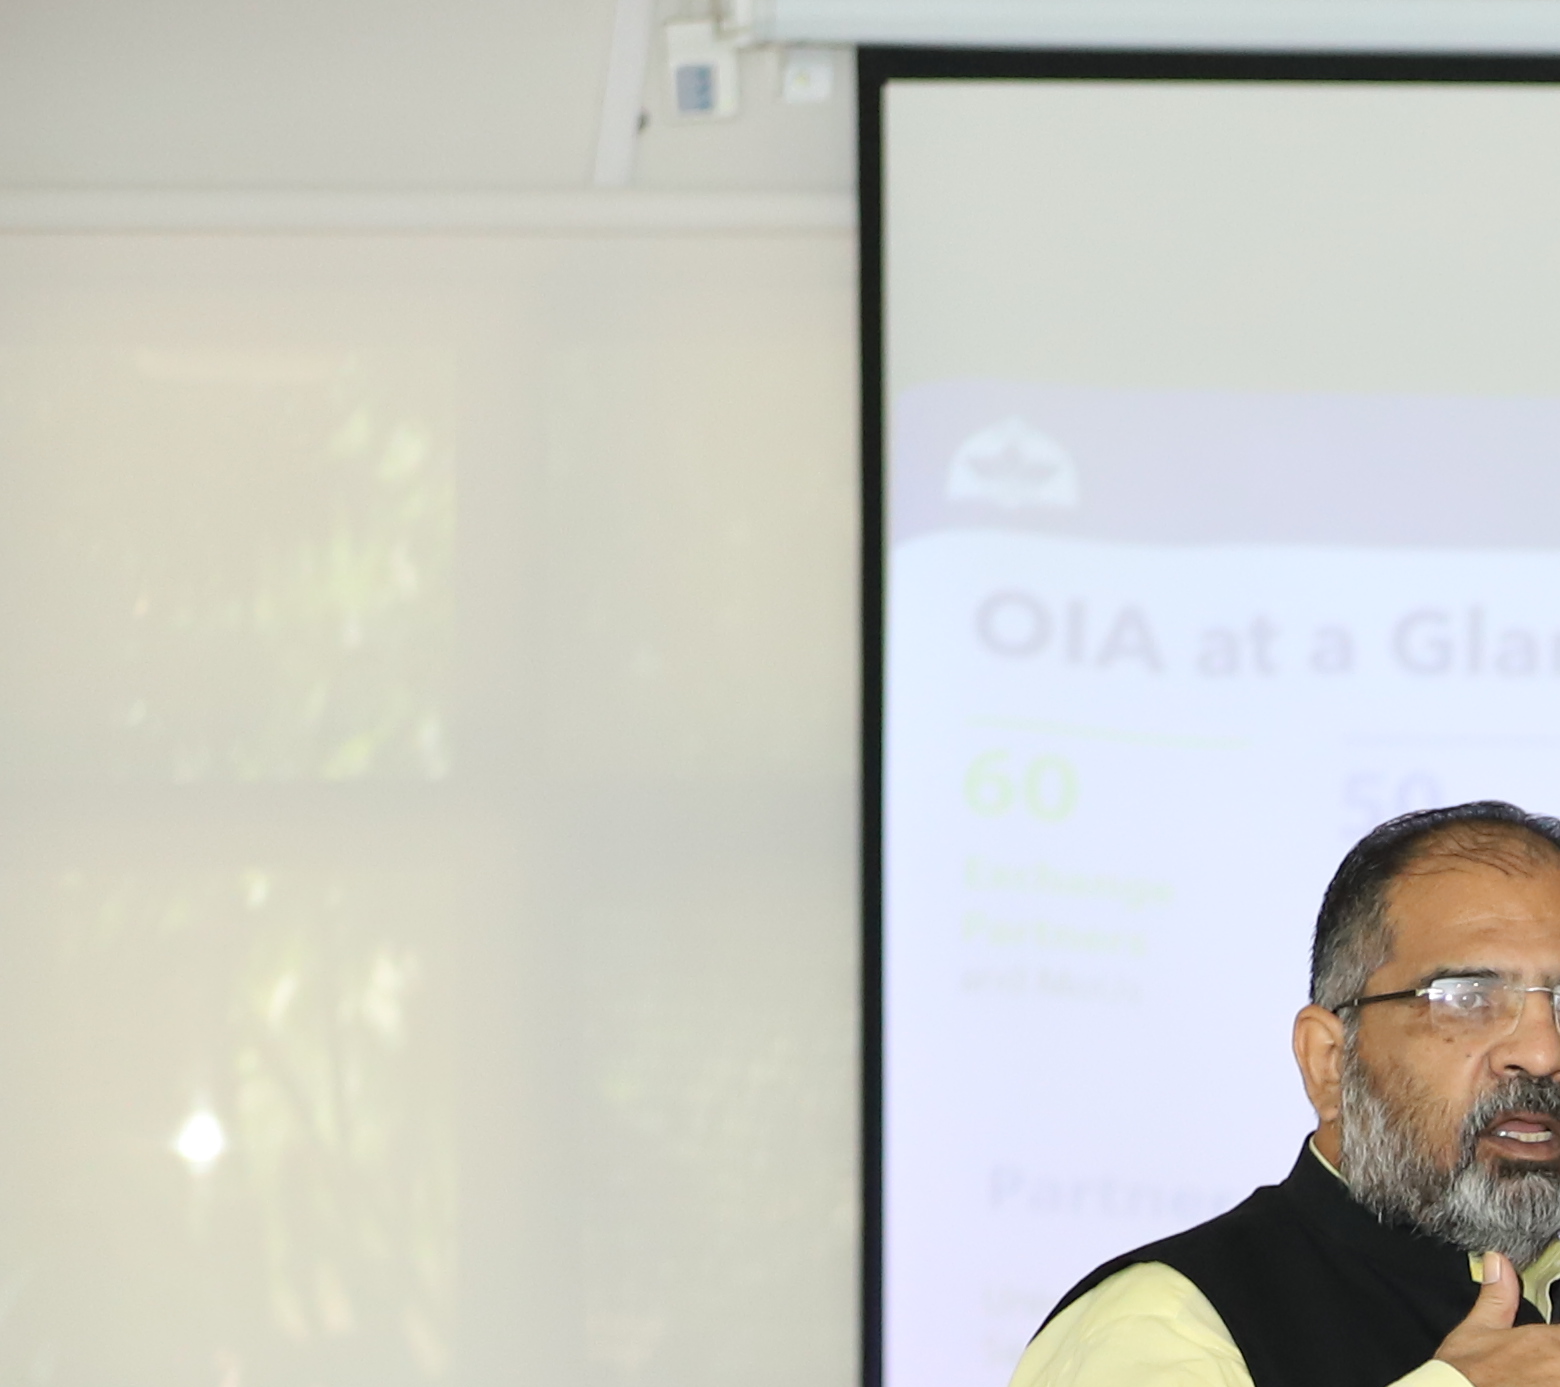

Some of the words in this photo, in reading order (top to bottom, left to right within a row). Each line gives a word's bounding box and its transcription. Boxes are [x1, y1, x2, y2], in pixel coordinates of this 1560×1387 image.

[972, 589, 1168, 677] OIA
[1194, 614, 1280, 679] at
[1307, 624, 1358, 677] a
[960, 746, 1082, 827] 60
